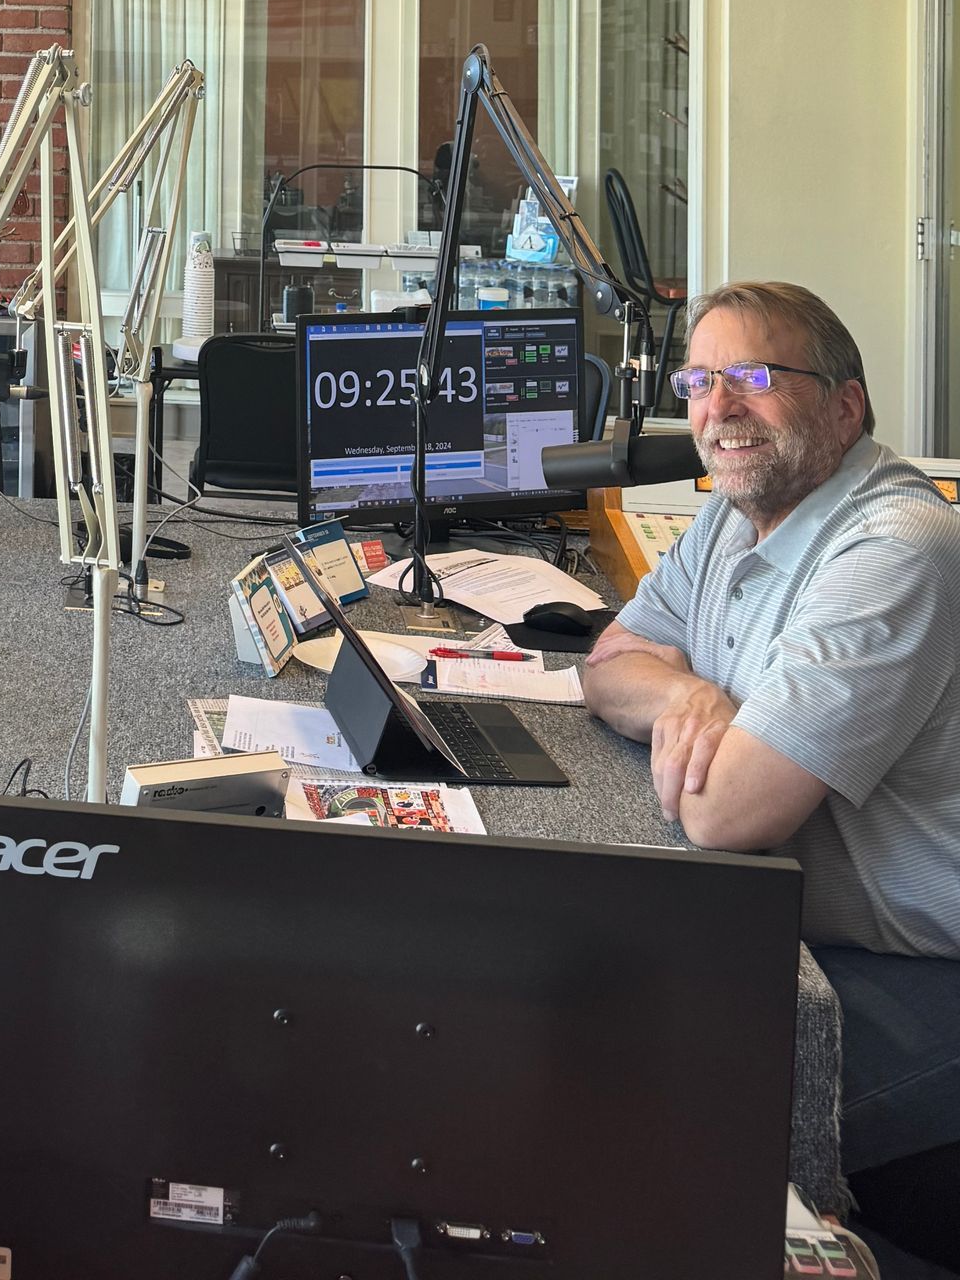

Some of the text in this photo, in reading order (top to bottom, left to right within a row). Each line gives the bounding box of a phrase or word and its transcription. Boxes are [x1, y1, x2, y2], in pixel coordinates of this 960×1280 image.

[314, 366, 478, 409] 09:2543
[345, 446, 385, 456] Wednesday,
[435, 442, 452, 450] 2024
